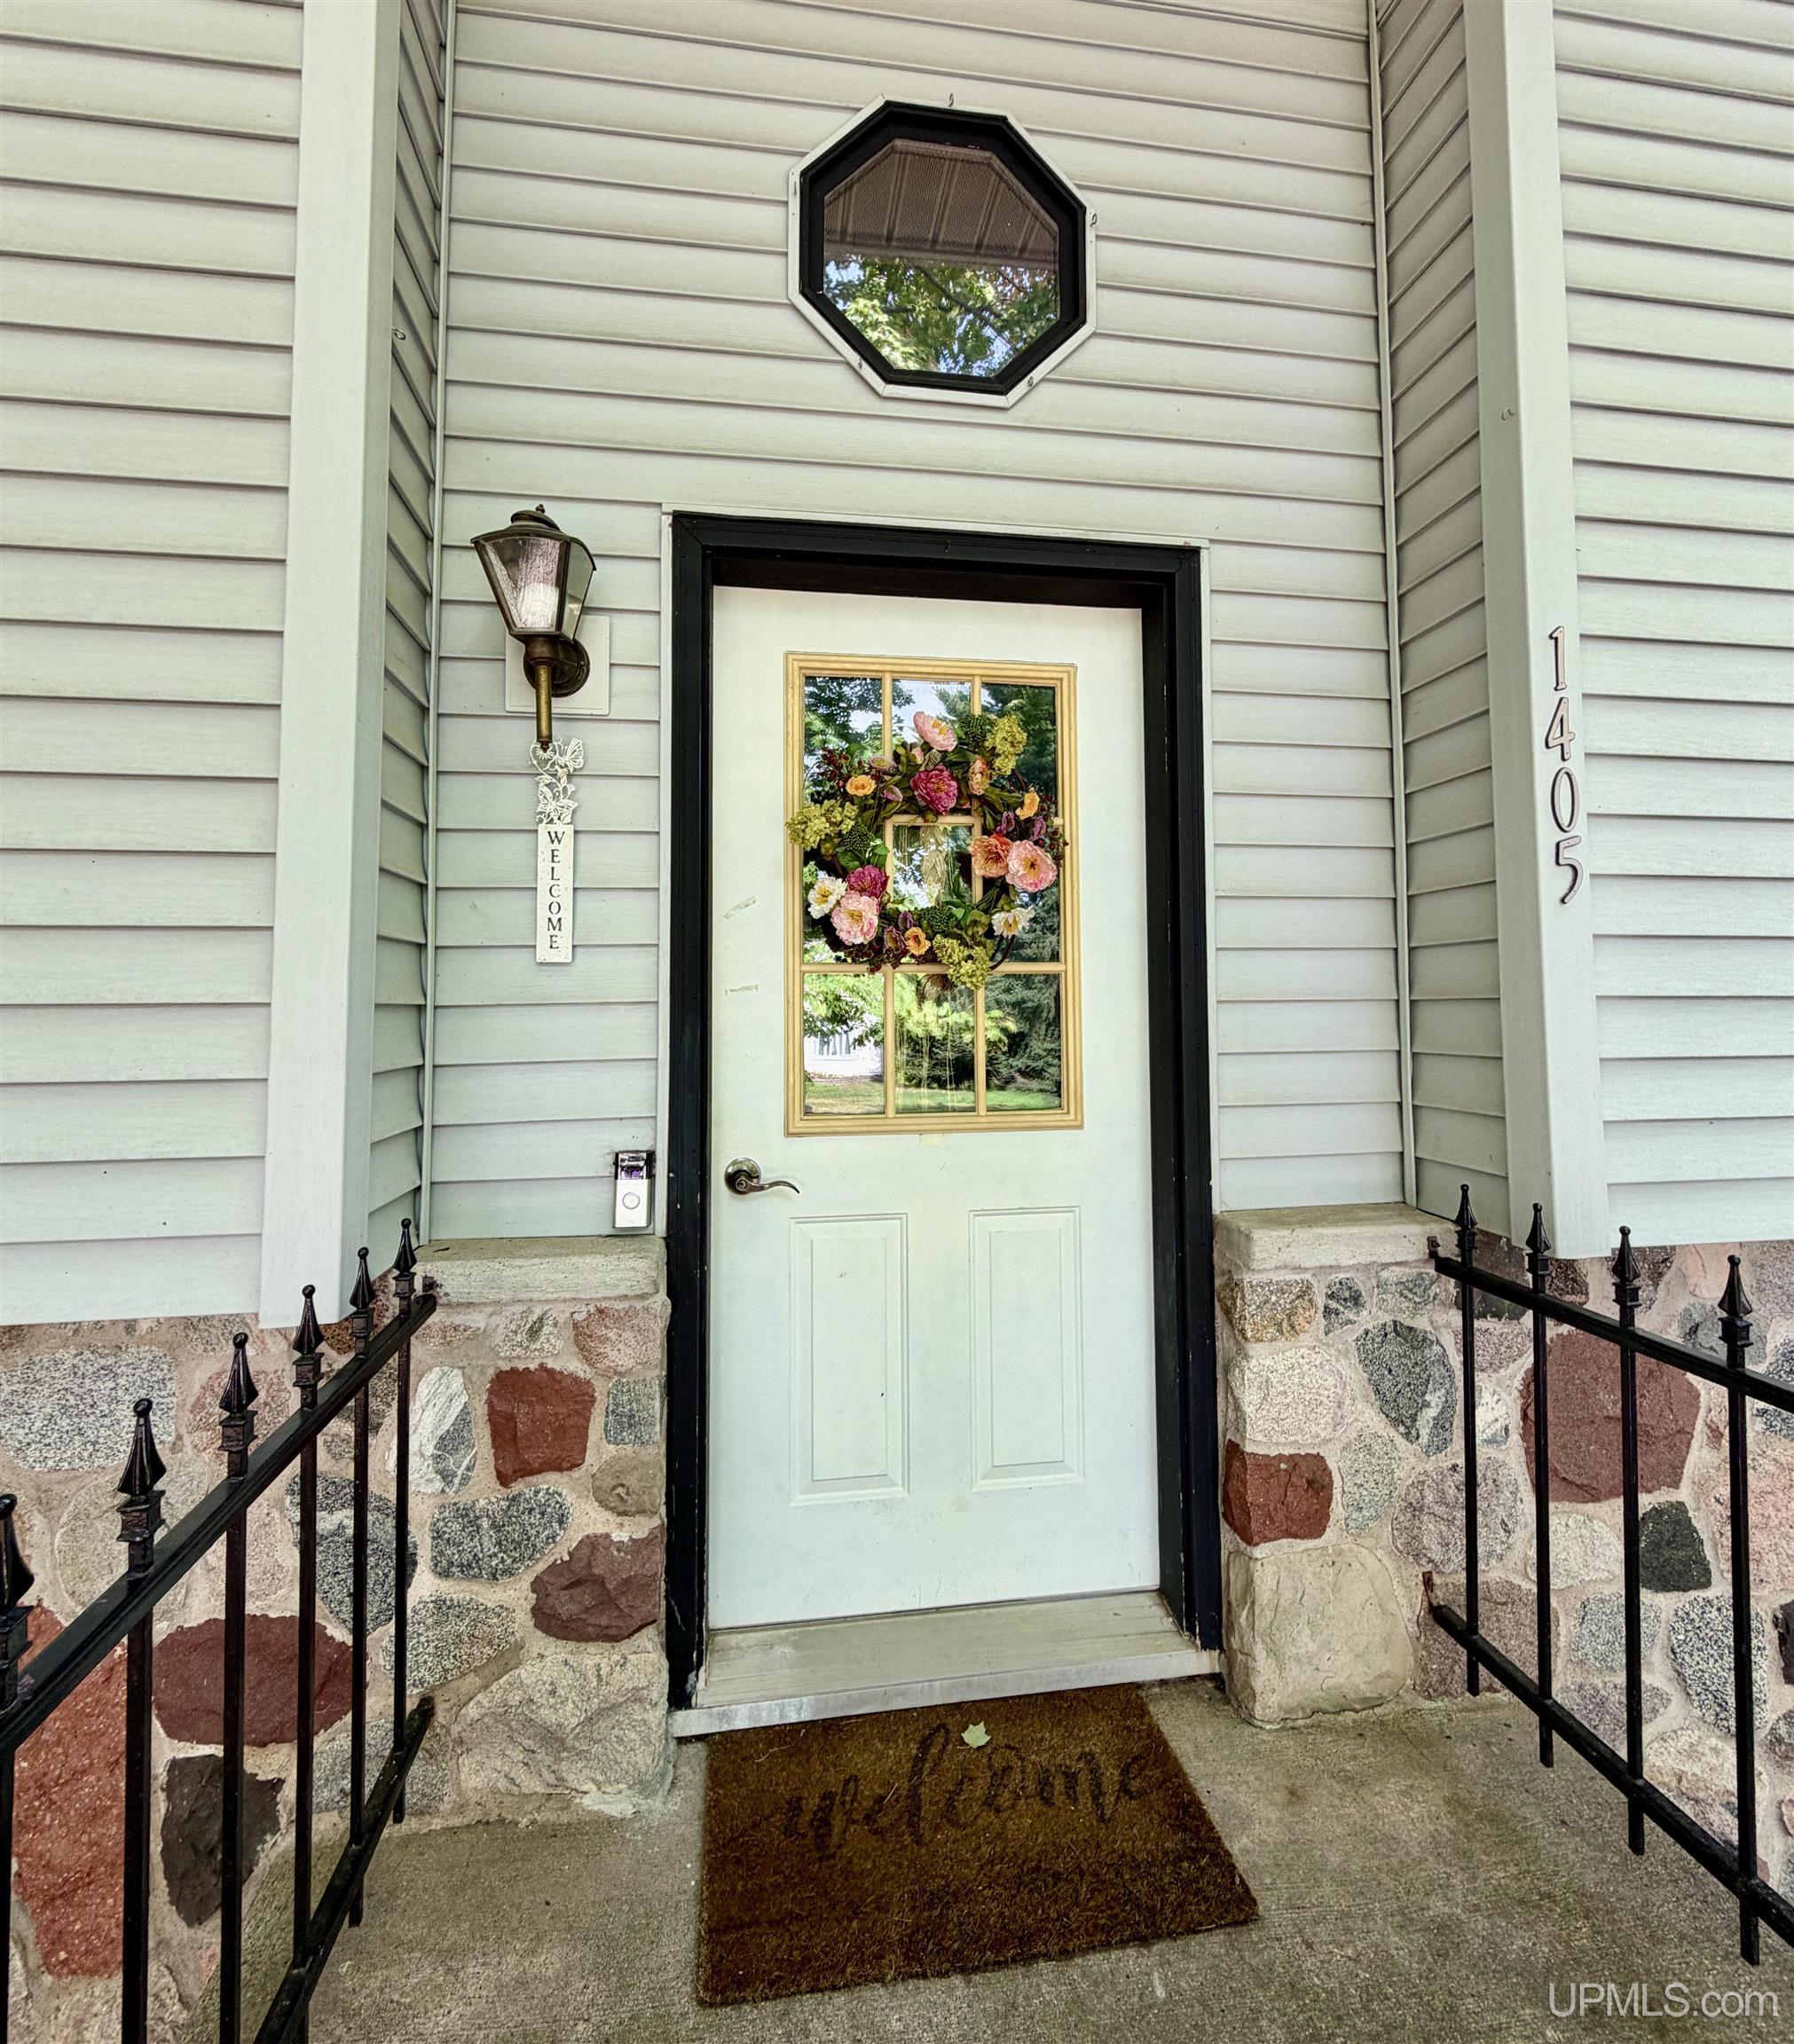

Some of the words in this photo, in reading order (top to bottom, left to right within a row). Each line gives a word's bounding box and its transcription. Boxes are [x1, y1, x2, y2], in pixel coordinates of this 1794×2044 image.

[1545, 625, 1584, 904] 1405
[547, 830, 565, 949] WELCOME
[782, 1722, 1157, 1860] welcome
